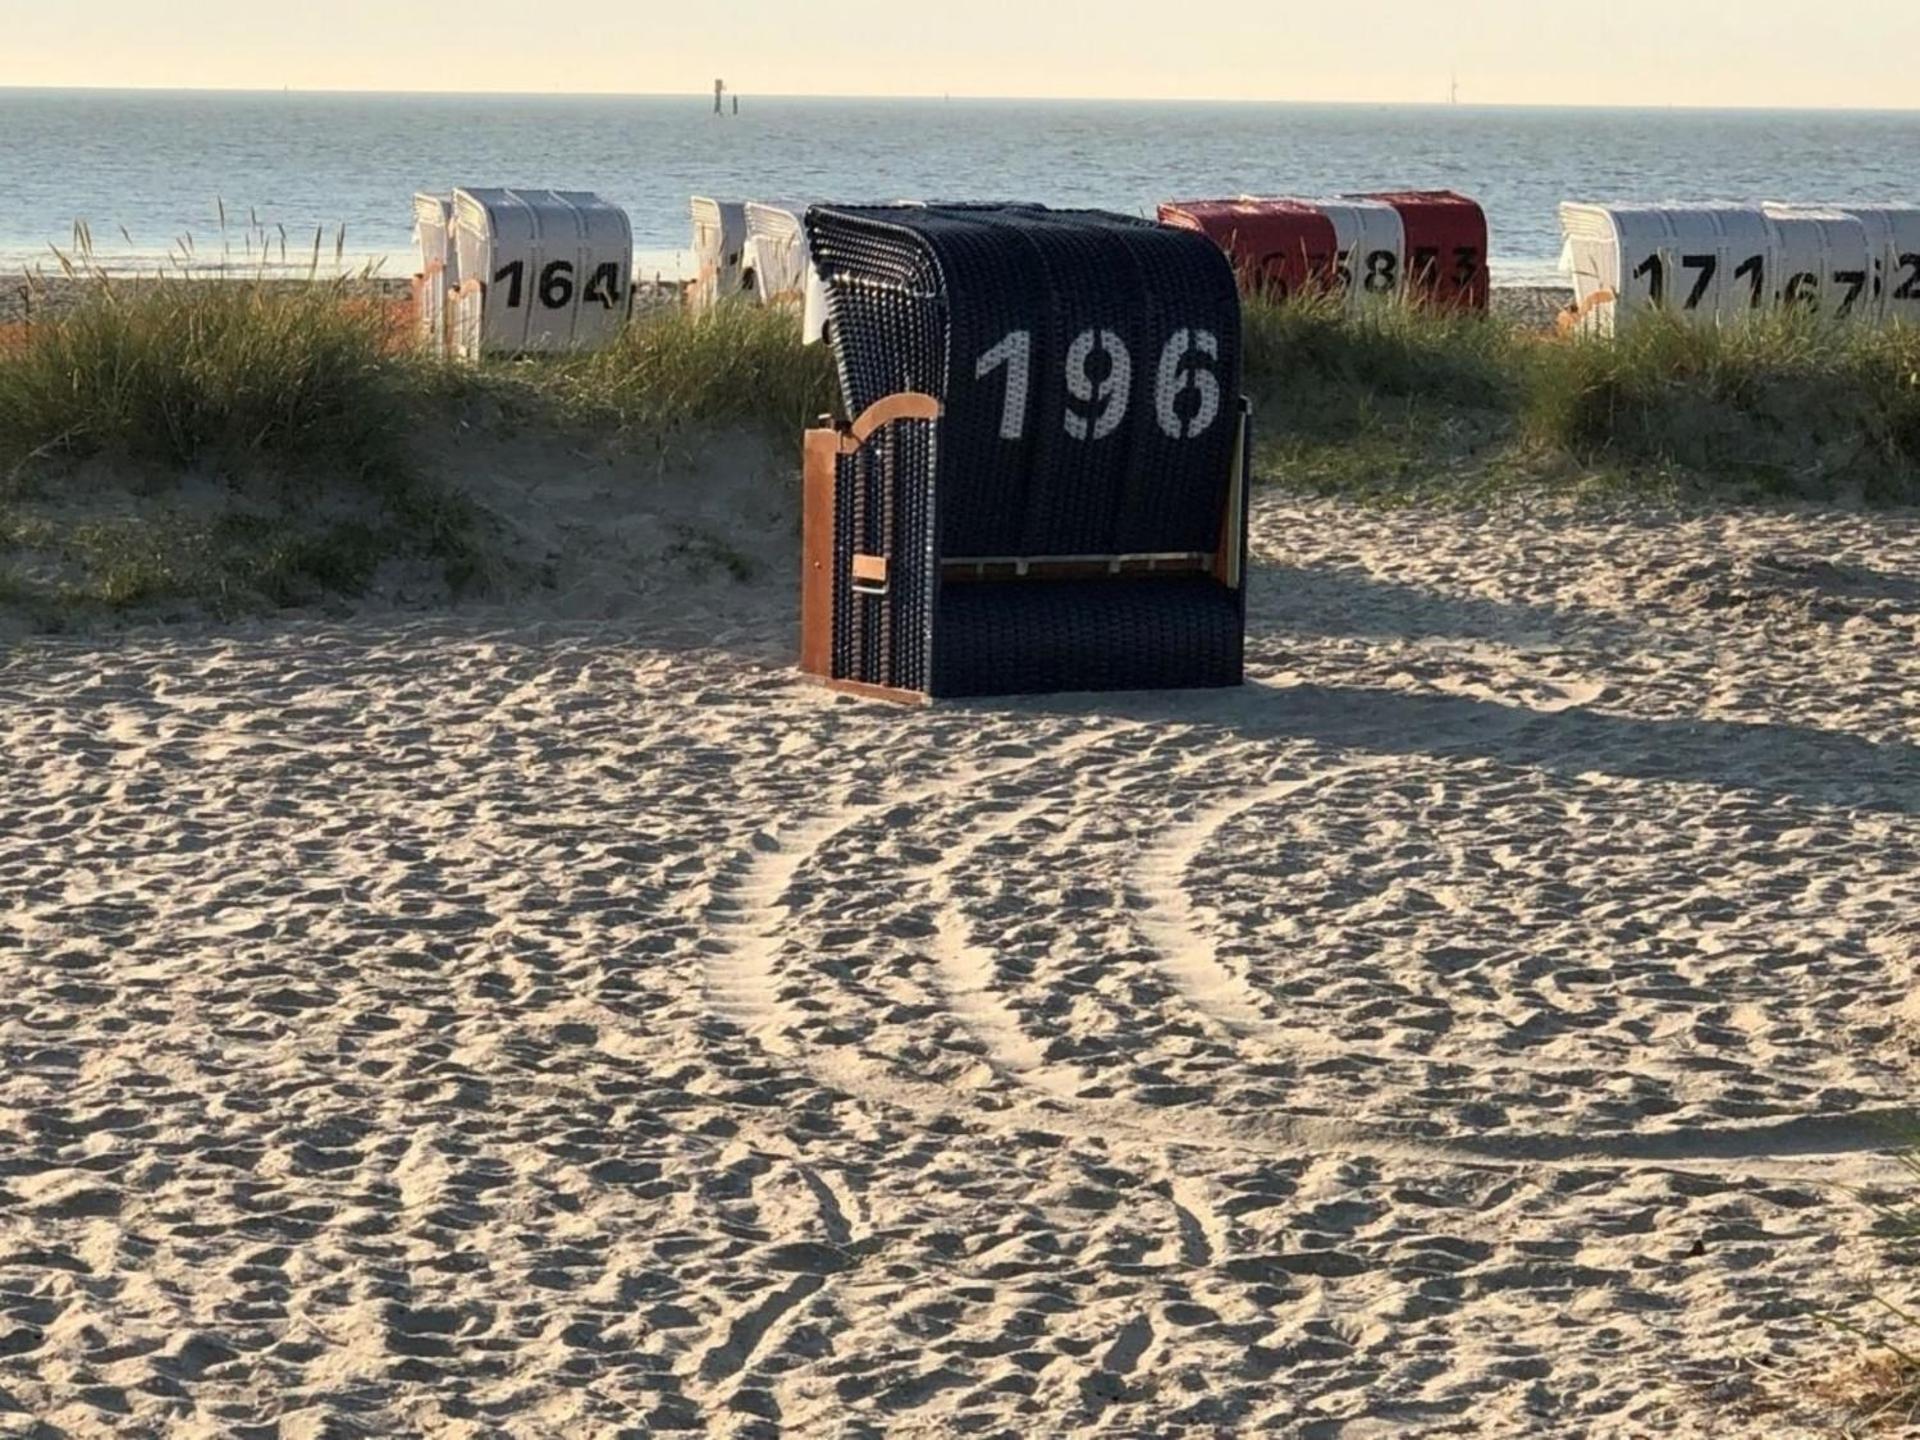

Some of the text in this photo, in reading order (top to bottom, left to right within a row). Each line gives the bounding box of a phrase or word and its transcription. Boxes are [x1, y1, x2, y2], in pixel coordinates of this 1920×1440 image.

[494, 260, 619, 309] 164
[1633, 254, 1763, 310] 171
[1774, 271, 1866, 318] 67
[975, 328, 1219, 440] 196
